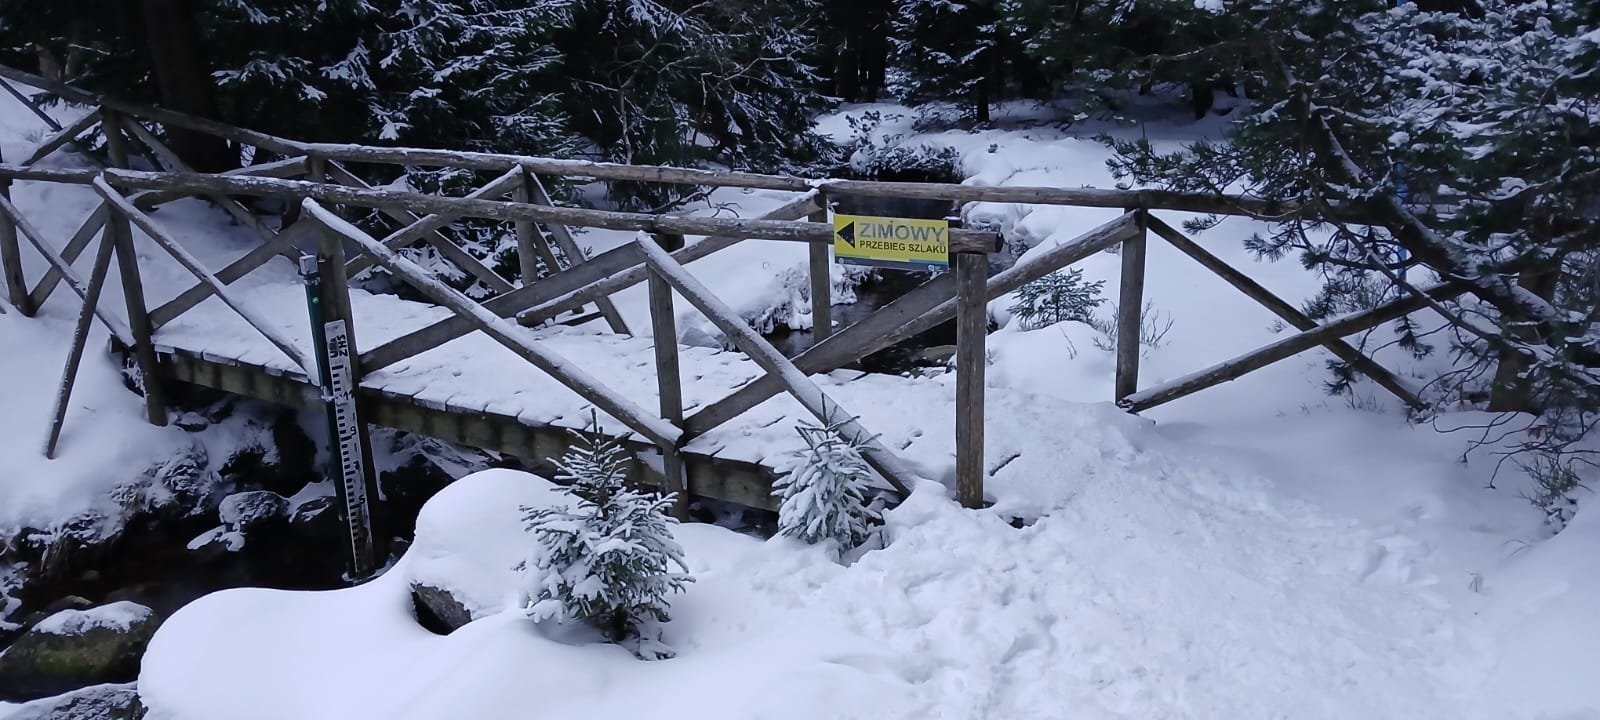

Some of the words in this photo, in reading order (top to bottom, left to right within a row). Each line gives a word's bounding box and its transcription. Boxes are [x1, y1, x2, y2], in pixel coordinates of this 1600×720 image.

[860, 222, 945, 243] ZIMOWY
[860, 240, 905, 251] PRZEBIEG
[908, 244, 946, 254] SZLAKU
